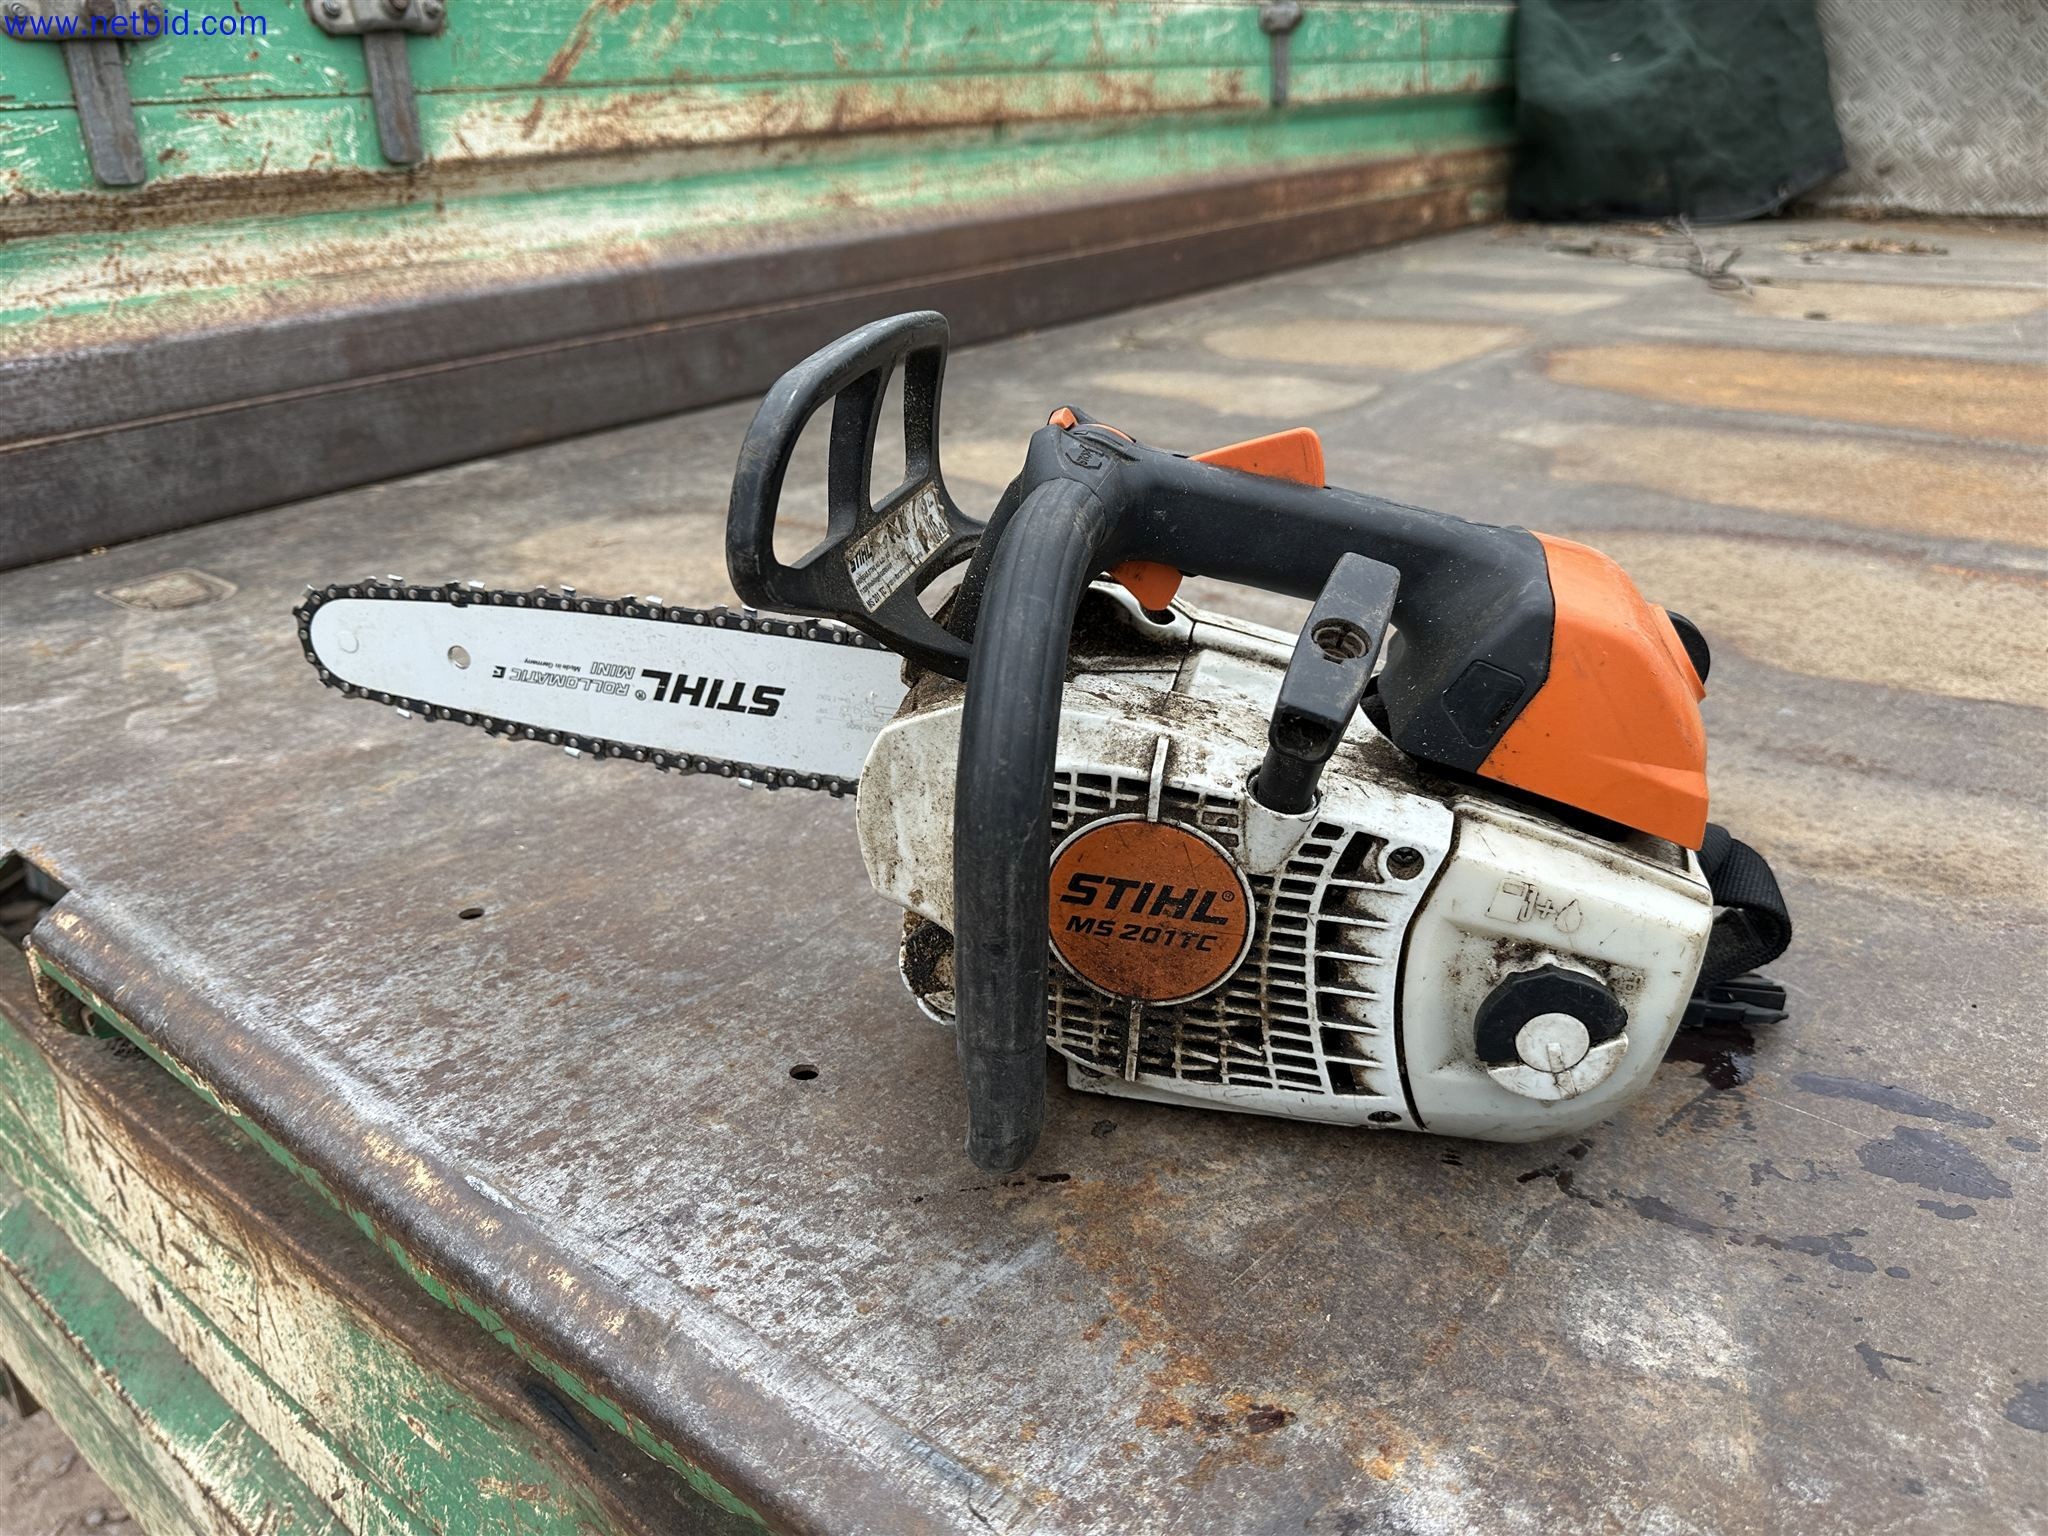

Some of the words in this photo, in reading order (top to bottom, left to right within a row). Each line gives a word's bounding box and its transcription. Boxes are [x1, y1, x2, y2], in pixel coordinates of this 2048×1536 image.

[509, 668, 630, 696] ROLLOMATIC
[590, 661, 636, 680] MINI
[641, 669, 786, 717] STIHL
[1060, 872, 1228, 926] STIHL
[1065, 915, 1116, 937] MS
[1119, 923, 1218, 952] 201TC
